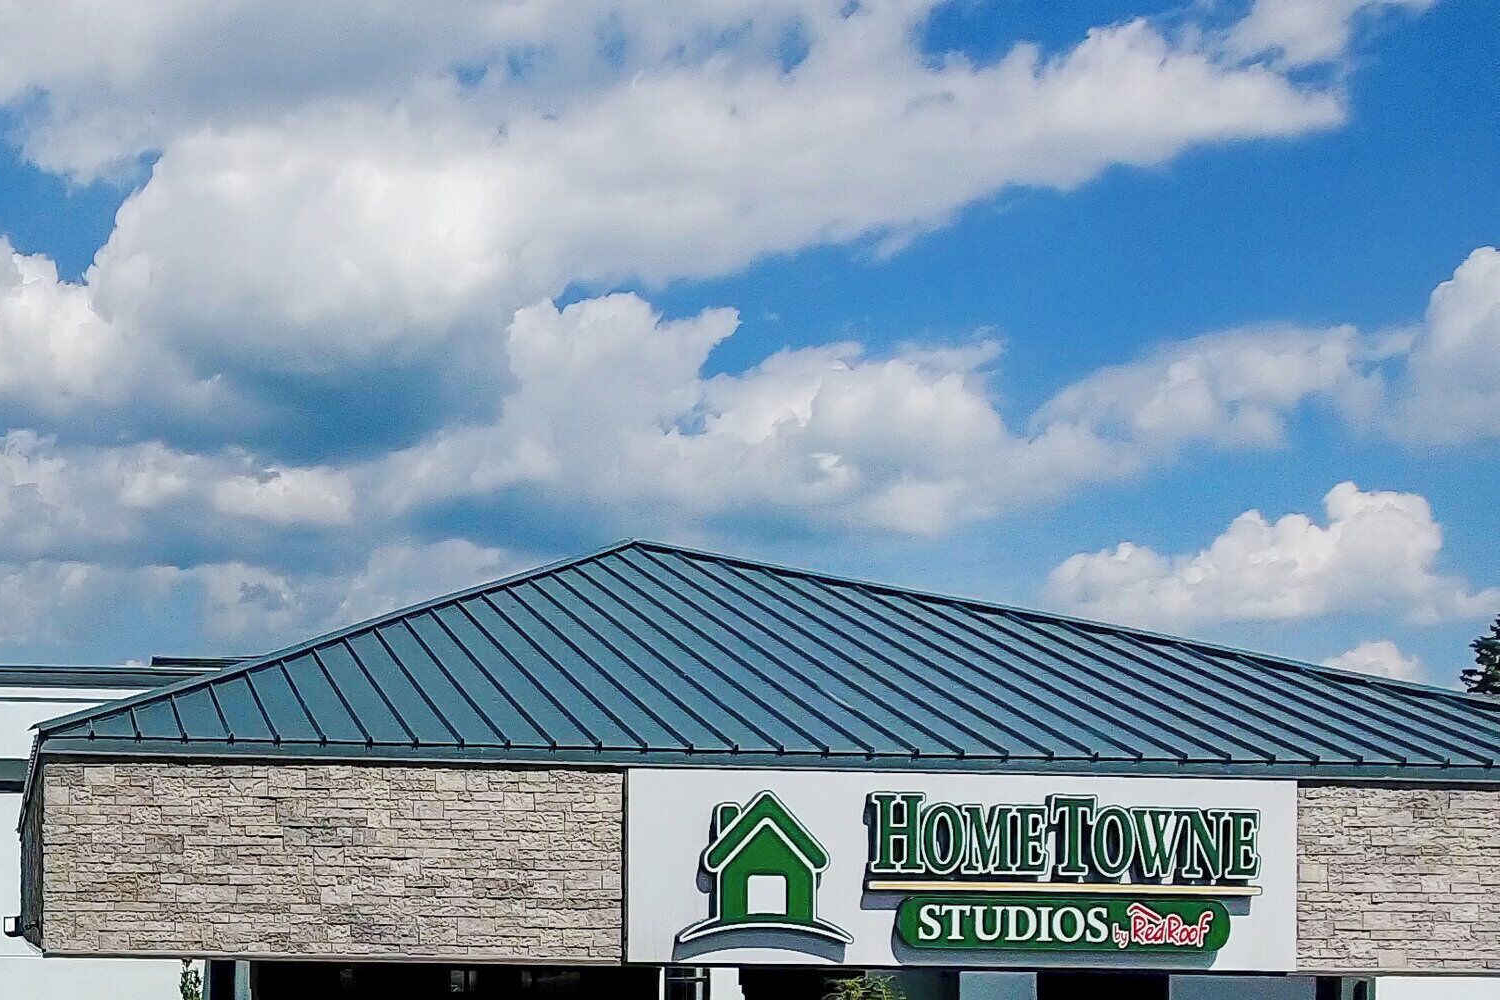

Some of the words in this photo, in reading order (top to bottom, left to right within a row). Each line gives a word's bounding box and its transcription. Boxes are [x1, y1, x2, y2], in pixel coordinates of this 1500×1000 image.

[871, 793, 1261, 879] HOMETOWNE
[918, 904, 1108, 942] STUDIOS
[1113, 923, 1129, 948] by
